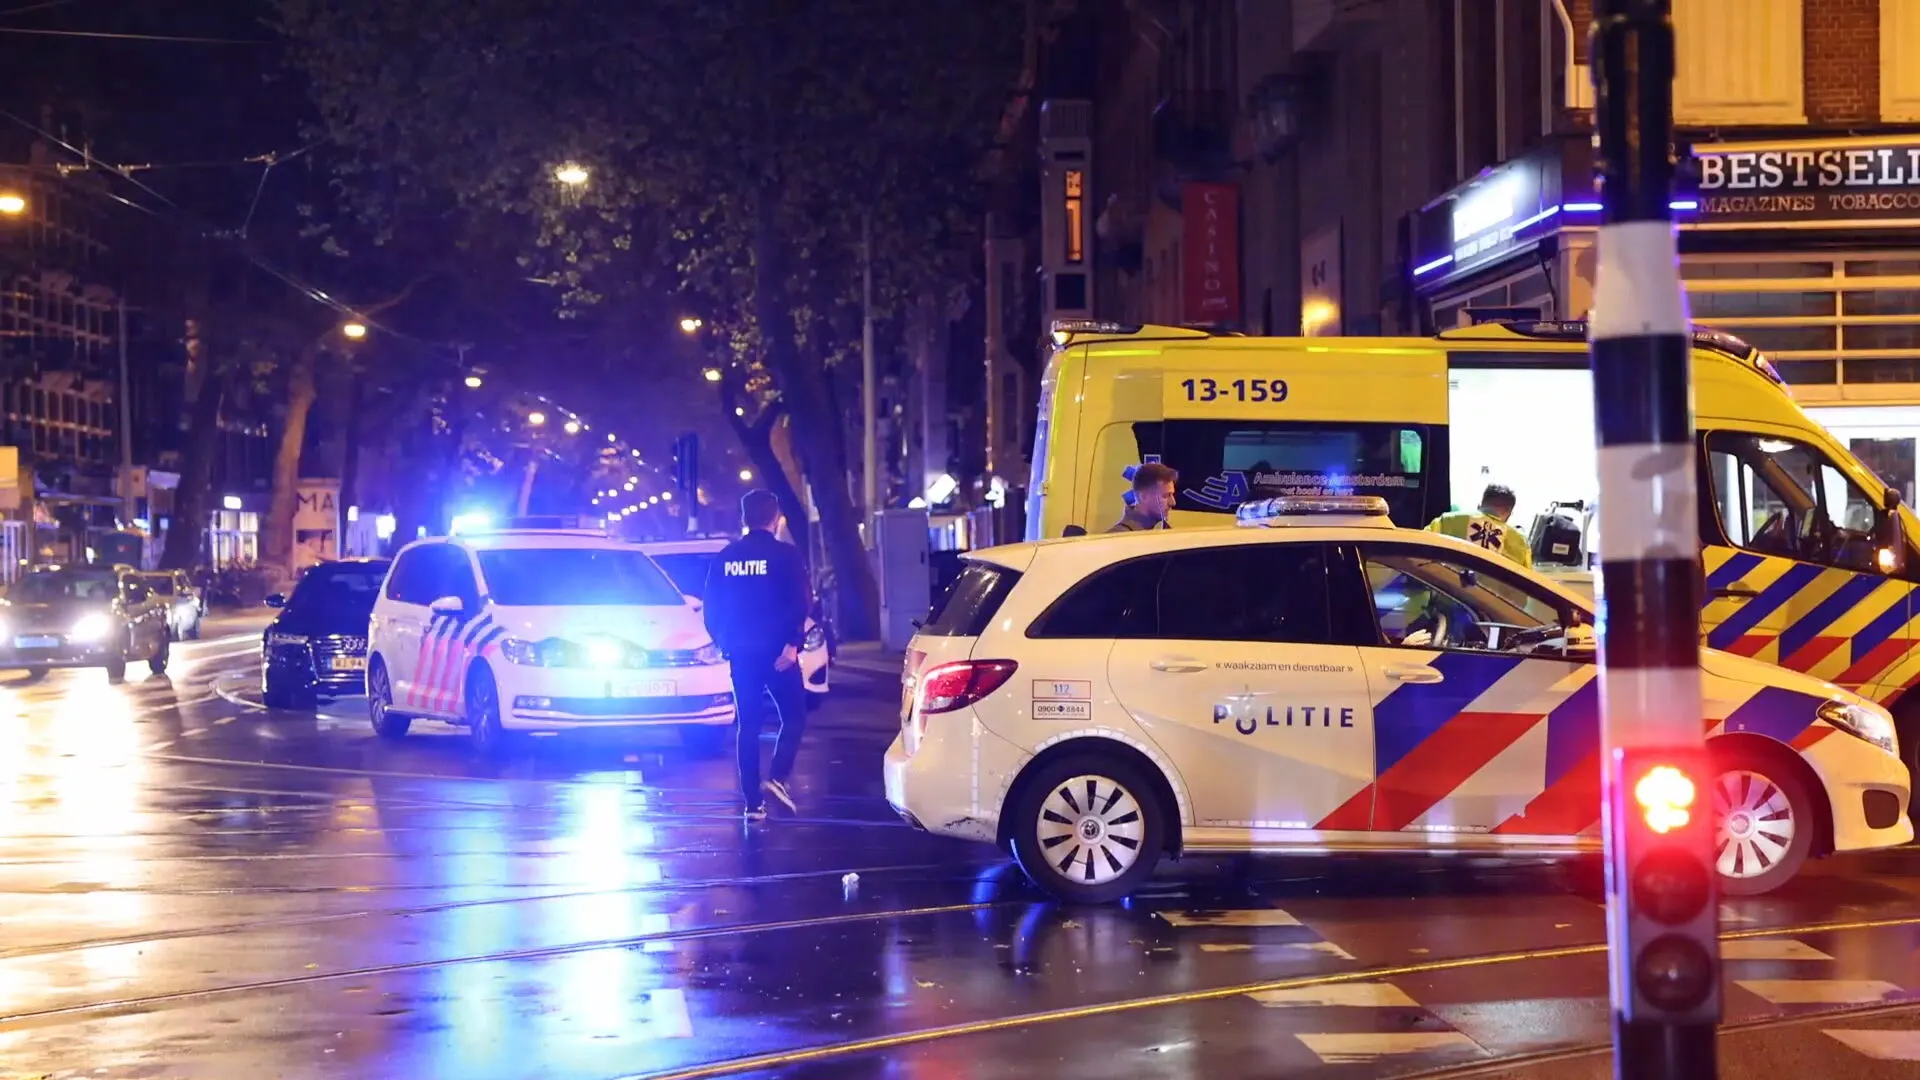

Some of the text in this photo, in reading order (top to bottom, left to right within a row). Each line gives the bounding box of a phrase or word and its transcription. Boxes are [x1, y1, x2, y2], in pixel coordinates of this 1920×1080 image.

[1700, 192, 1920, 213] MAGAZINES TOBACCO
[1181, 378, 1289, 402] 13-159
[1254, 472, 1327, 486] Ambulance
[724, 559, 768, 577] POLITIE
[1223, 661, 1277, 671] waakzaam
[1278, 663, 1291, 672] en
[1293, 662, 1346, 673] dienstbaar
[1214, 703, 1354, 735] POLITIE
